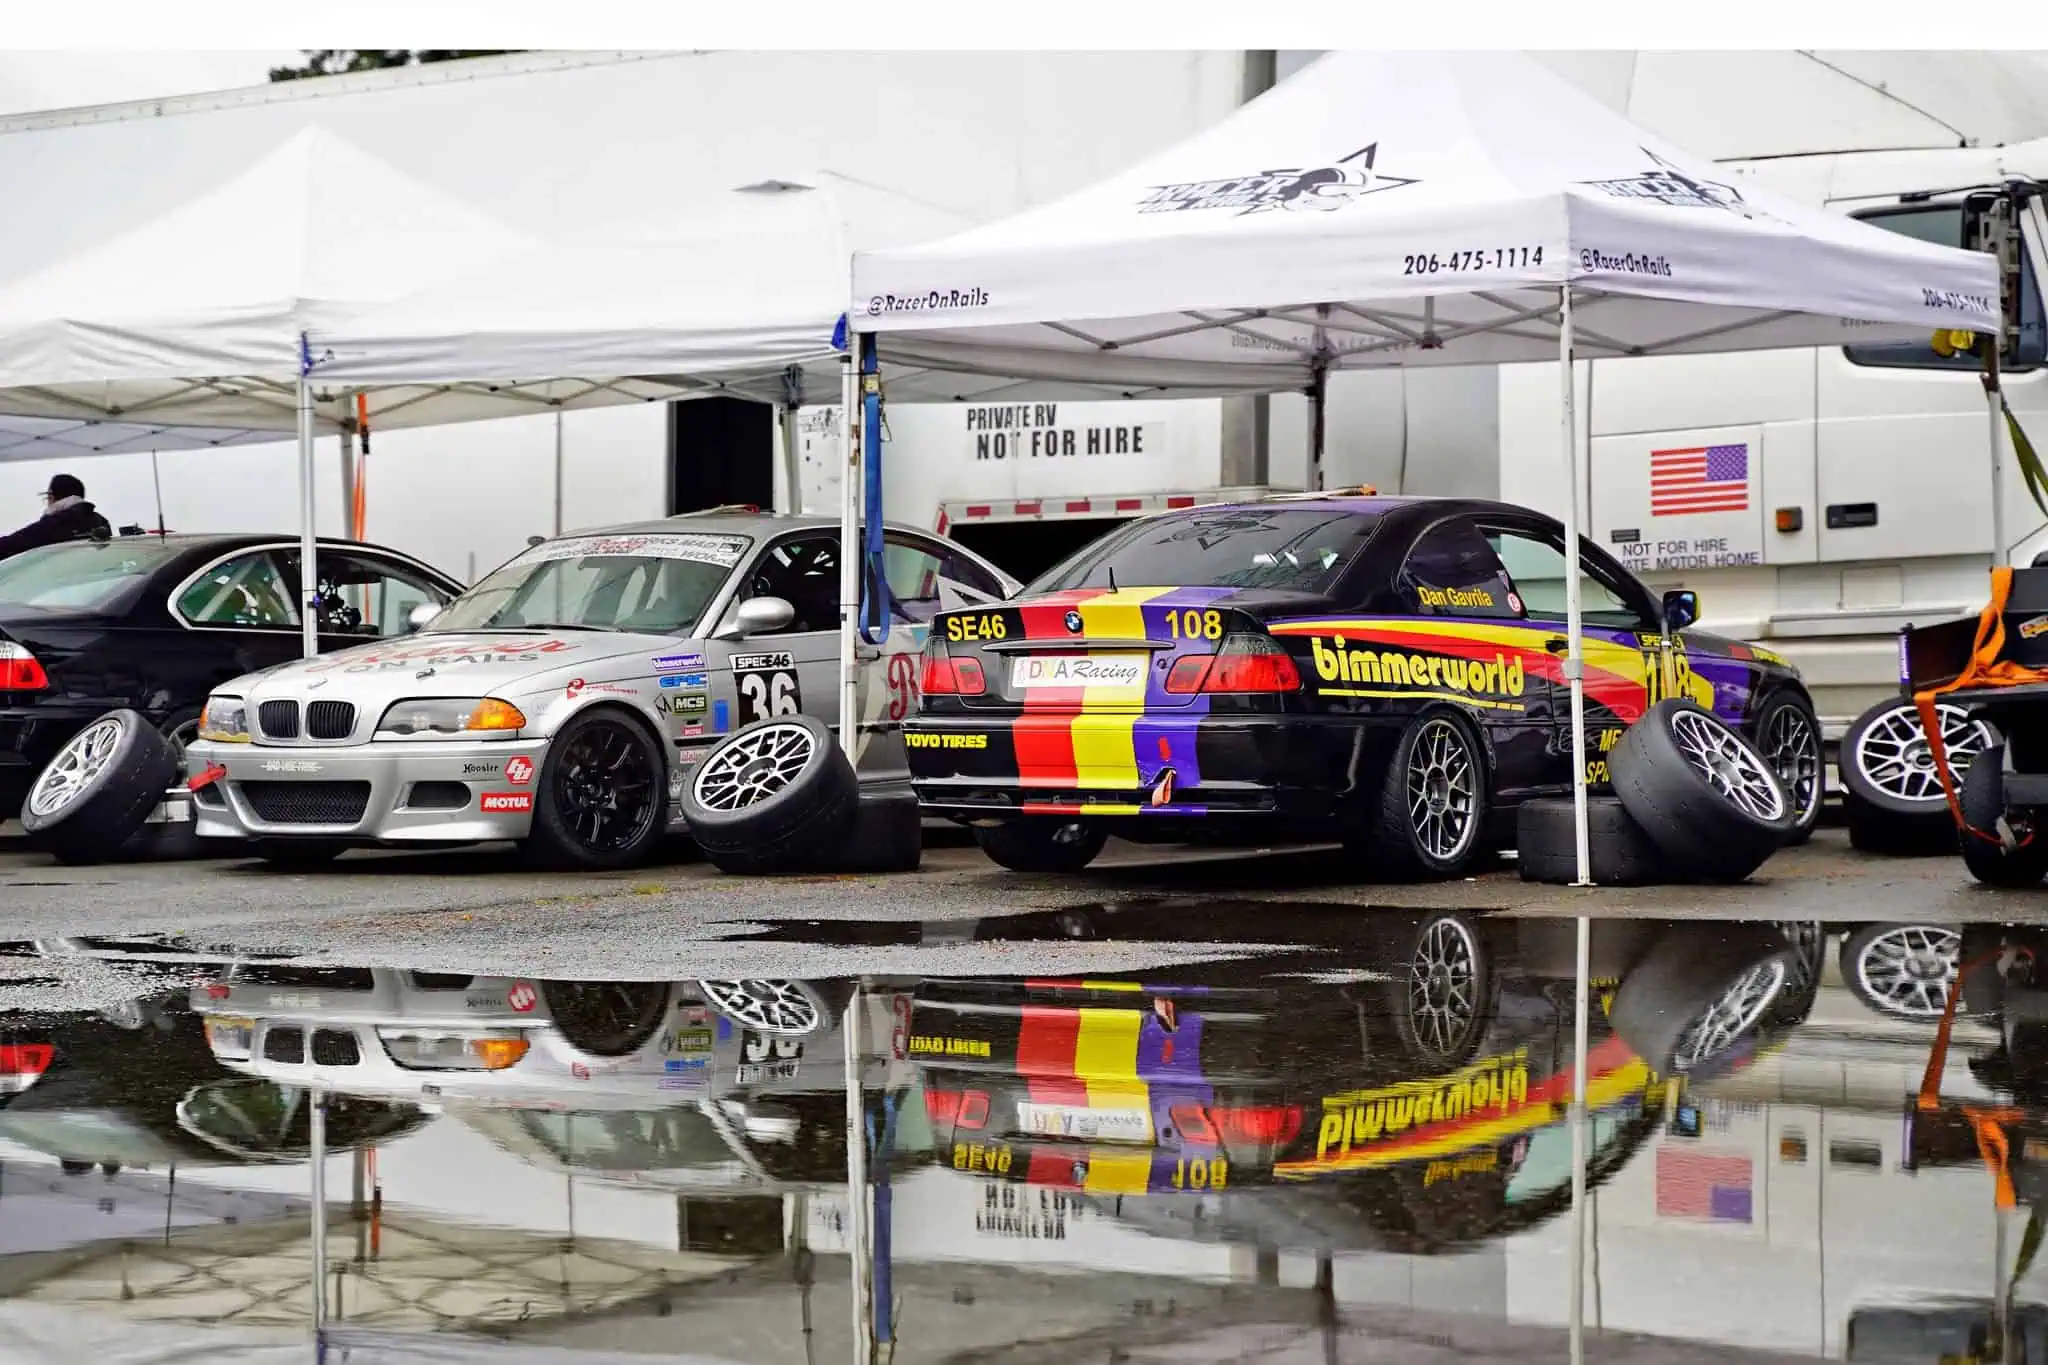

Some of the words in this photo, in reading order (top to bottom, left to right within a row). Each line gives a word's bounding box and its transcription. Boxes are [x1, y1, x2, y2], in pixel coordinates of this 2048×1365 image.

[1404, 246, 1544, 275] 206-475-1114
[1580, 249, 1672, 277] @RacerOnRails
[867, 287, 990, 316] @RacerOnRails
[967, 405, 1031, 430] PRIVATE
[1035, 403, 1057, 427] RV
[1031, 429, 1076, 457] FOR
[1087, 425, 1144, 455] HIRE
[1622, 543, 1651, 557] NOT
[1658, 540, 1689, 555] FOR
[1694, 538, 1729, 553] HIRE
[1656, 554, 1709, 570] MOTOR
[1715, 551, 1761, 568] HOME
[1416, 586, 1448, 606] Dan
[946, 614, 1007, 642] SE46
[1165, 610, 1223, 640] 108
[1071, 659, 1140, 685] Racing
[1311, 634, 1526, 697] bimmerworld
[1646, 652, 1691, 705] 18
[675, 696, 705, 709] MCS
[741, 672, 798, 721] 36
[904, 733, 941, 748] TOYO
[942, 734, 987, 749] TIRES
[484, 796, 529, 809] MOTUL
